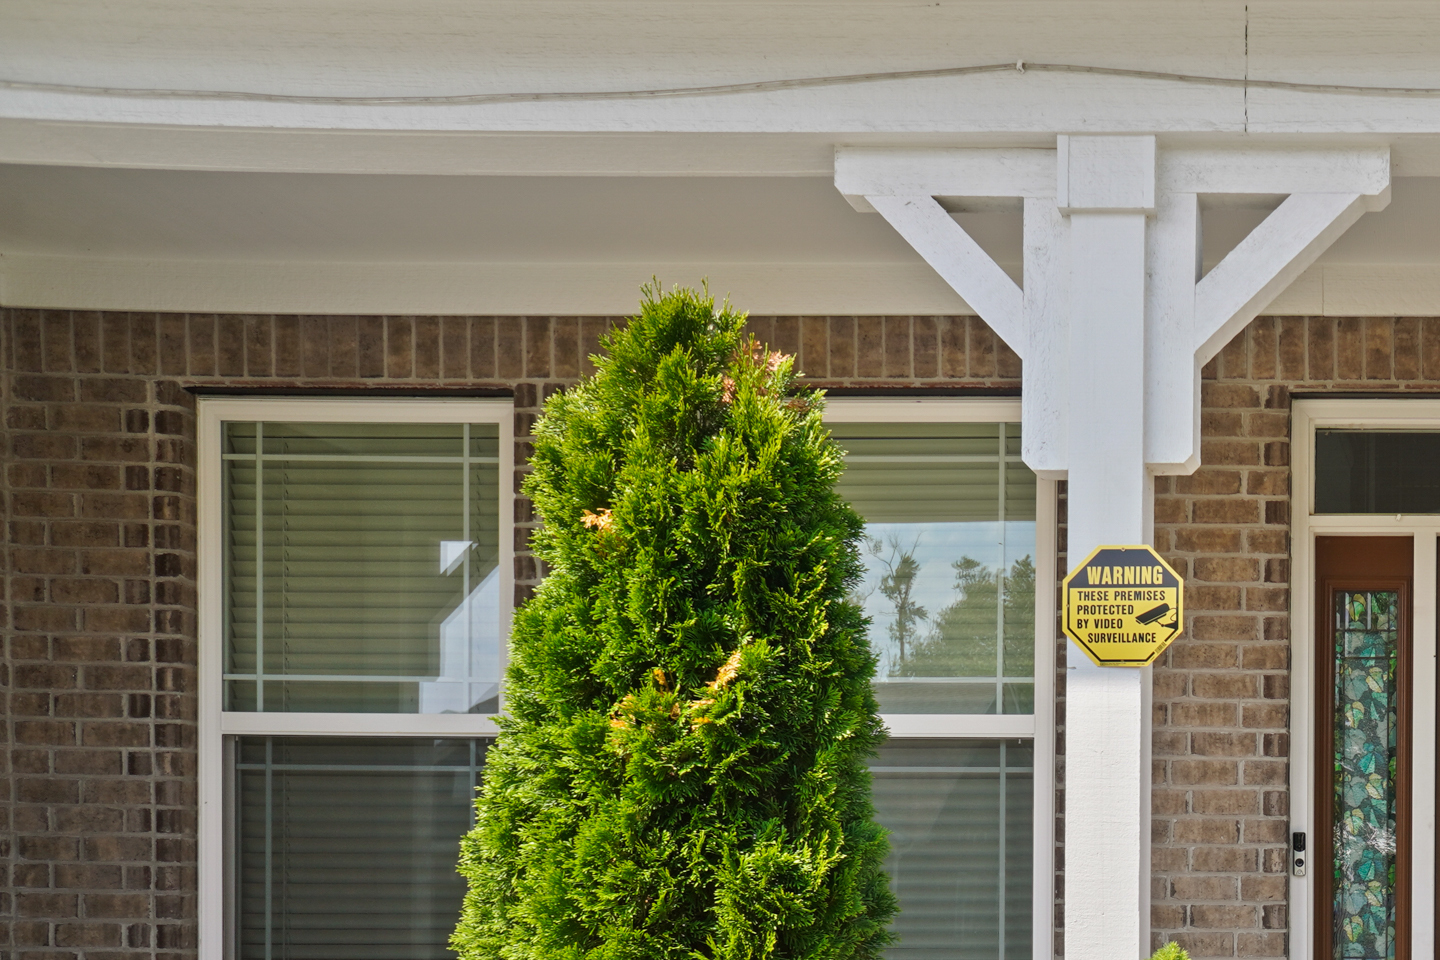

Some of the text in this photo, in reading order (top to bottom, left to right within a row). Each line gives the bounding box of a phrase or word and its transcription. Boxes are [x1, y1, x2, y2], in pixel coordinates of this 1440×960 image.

[1086, 565, 1163, 585] WARNING
[1077, 590, 1166, 601] THESE PREMISES
[1076, 604, 1134, 615] PROTECTED
[1076, 618, 1123, 629] BY VIDEO
[1087, 632, 1157, 643] SURVEILLANCE
